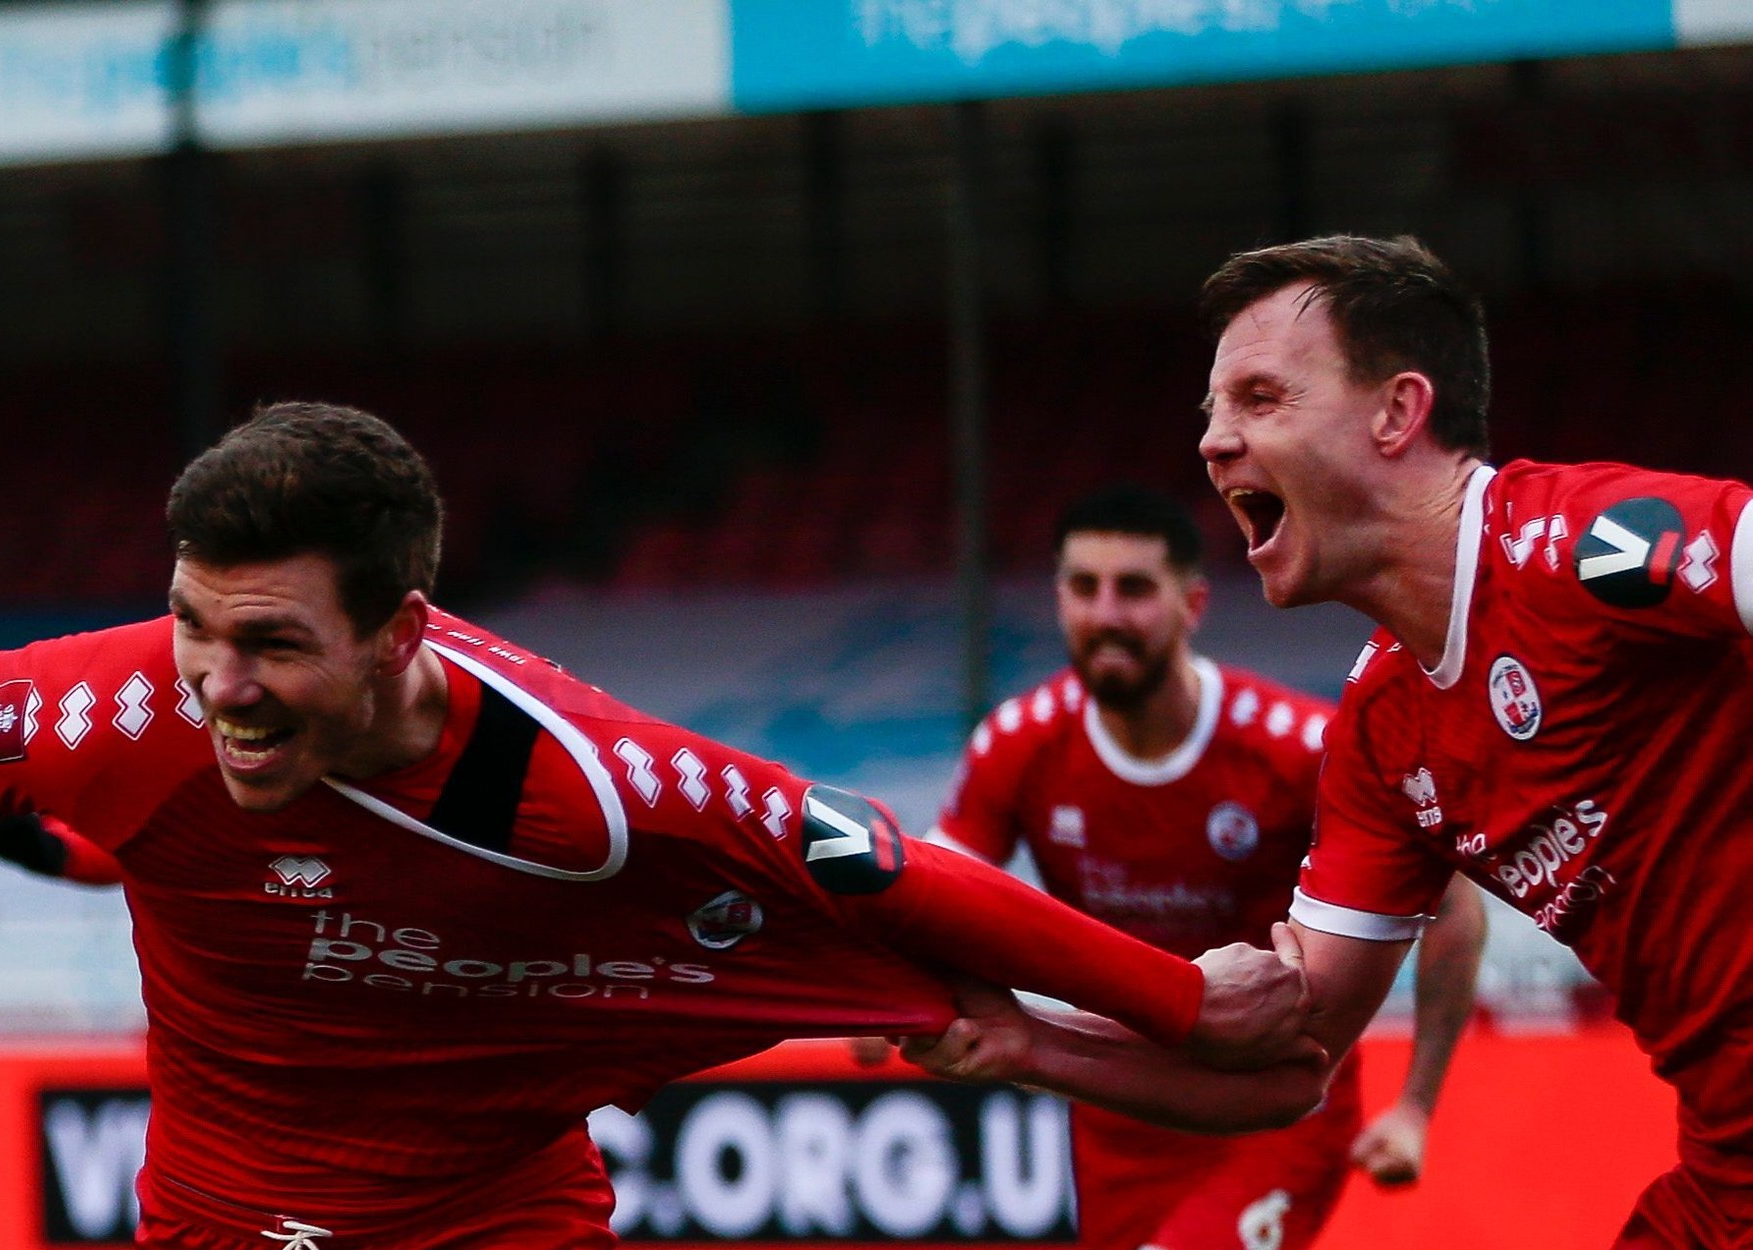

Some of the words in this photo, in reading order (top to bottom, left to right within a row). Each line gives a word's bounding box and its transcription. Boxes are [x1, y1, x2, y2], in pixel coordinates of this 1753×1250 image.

[1490, 800, 1608, 898] eople's
[310, 910, 441, 950] the
[302, 962, 648, 999] pension
[308, 938, 715, 984] people's
